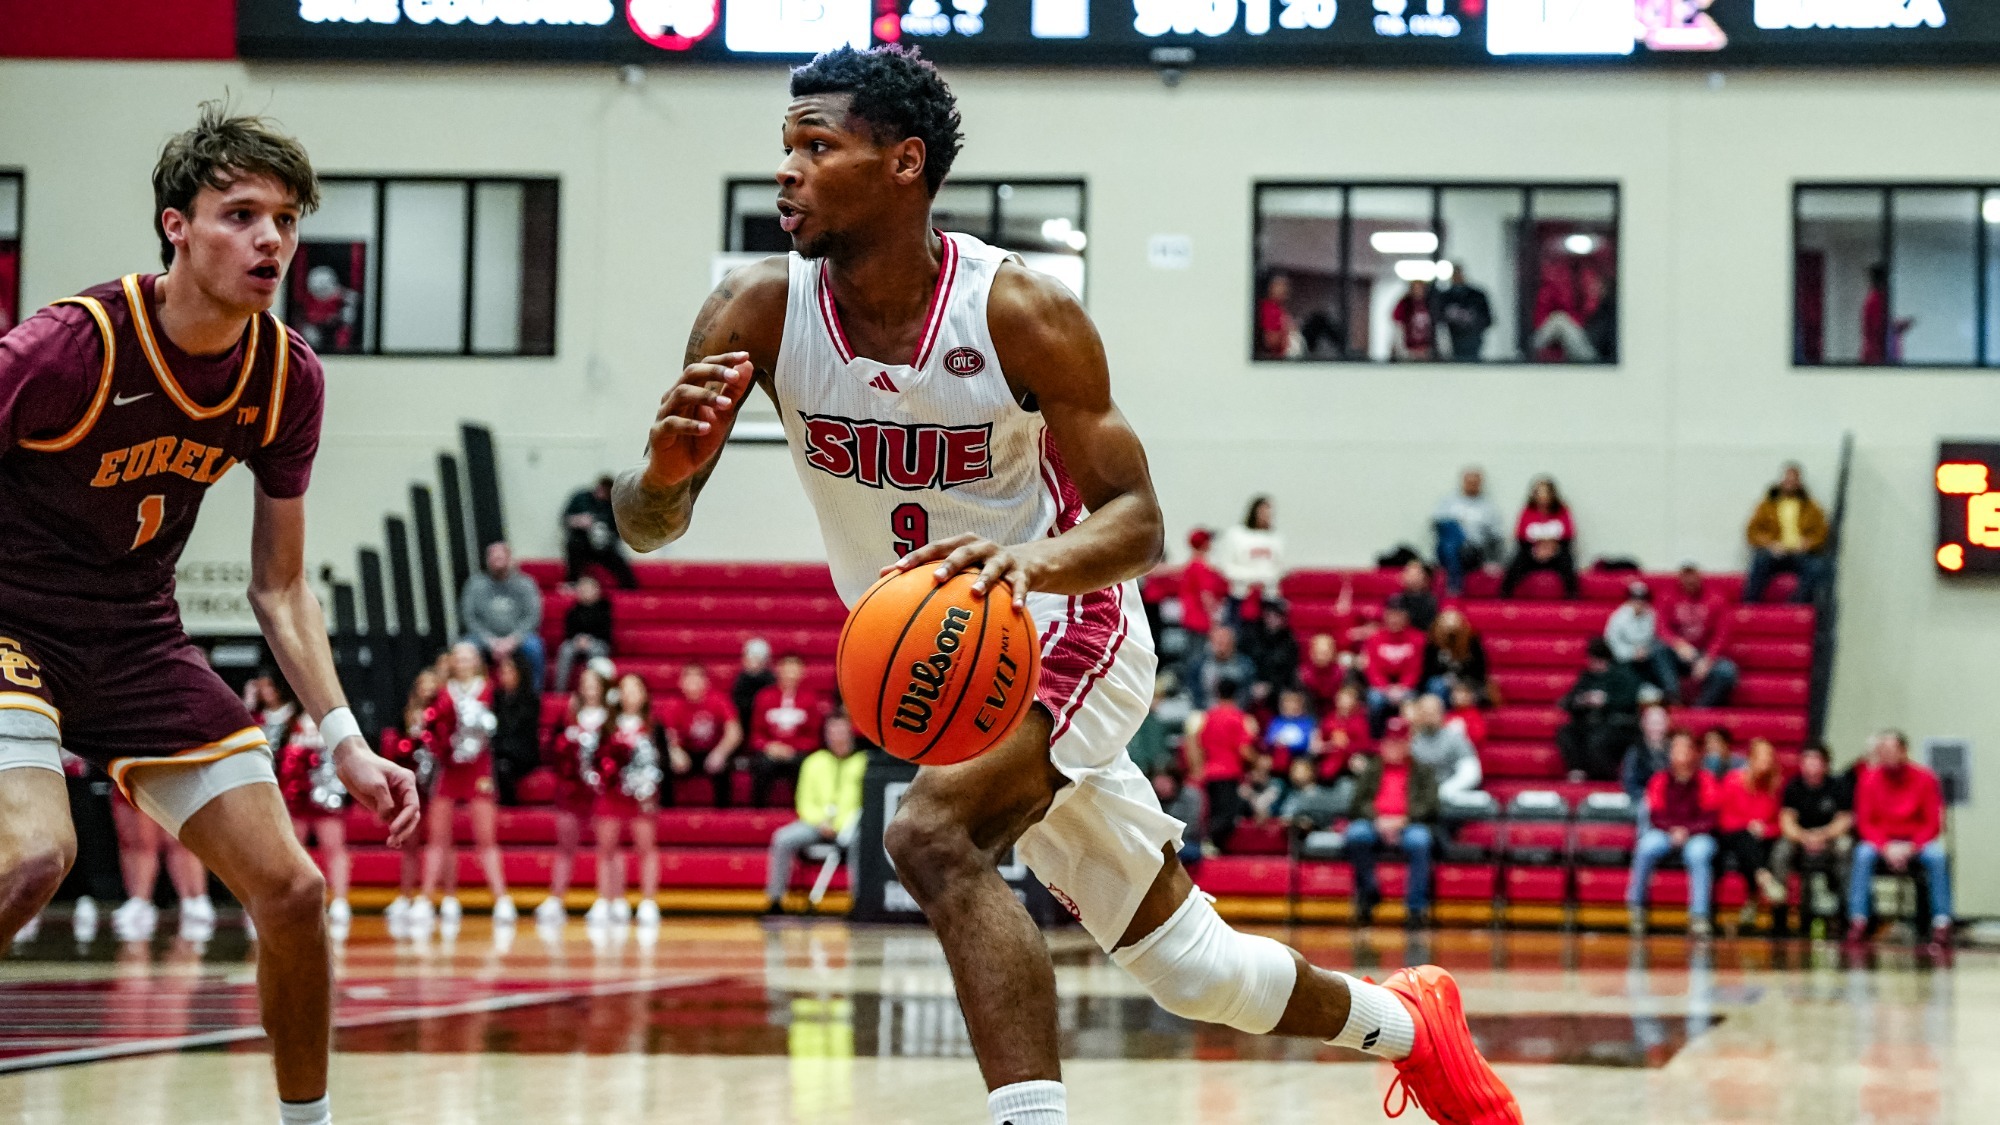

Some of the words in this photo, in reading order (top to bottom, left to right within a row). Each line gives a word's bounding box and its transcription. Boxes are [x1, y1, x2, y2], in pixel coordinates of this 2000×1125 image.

[952, 355, 976, 369] OVC
[236, 406, 260, 426] TW
[797, 410, 993, 491] SIUE
[130, 494, 166, 551] 1
[891, 502, 928, 558] 9
[893, 606, 973, 734] Wilson
[974, 653, 1017, 733] EVO
